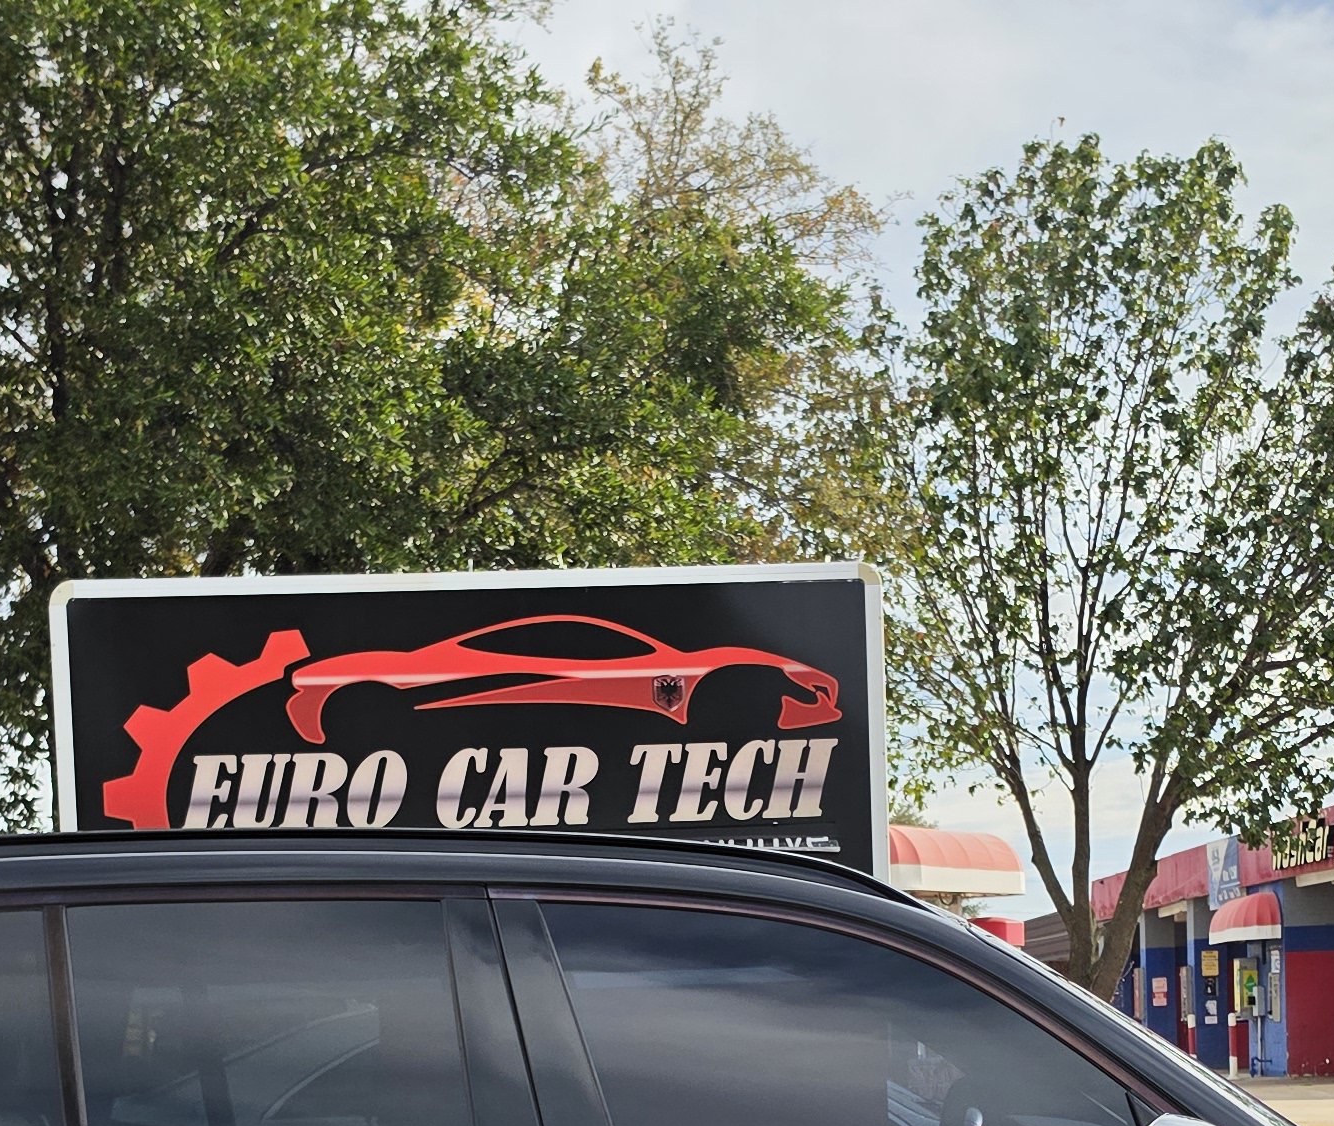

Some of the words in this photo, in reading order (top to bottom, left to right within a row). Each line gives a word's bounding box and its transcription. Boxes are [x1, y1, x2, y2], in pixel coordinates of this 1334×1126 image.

[182, 750, 408, 828] EURO
[436, 747, 599, 828] CAR
[627, 738, 839, 823] TECH
